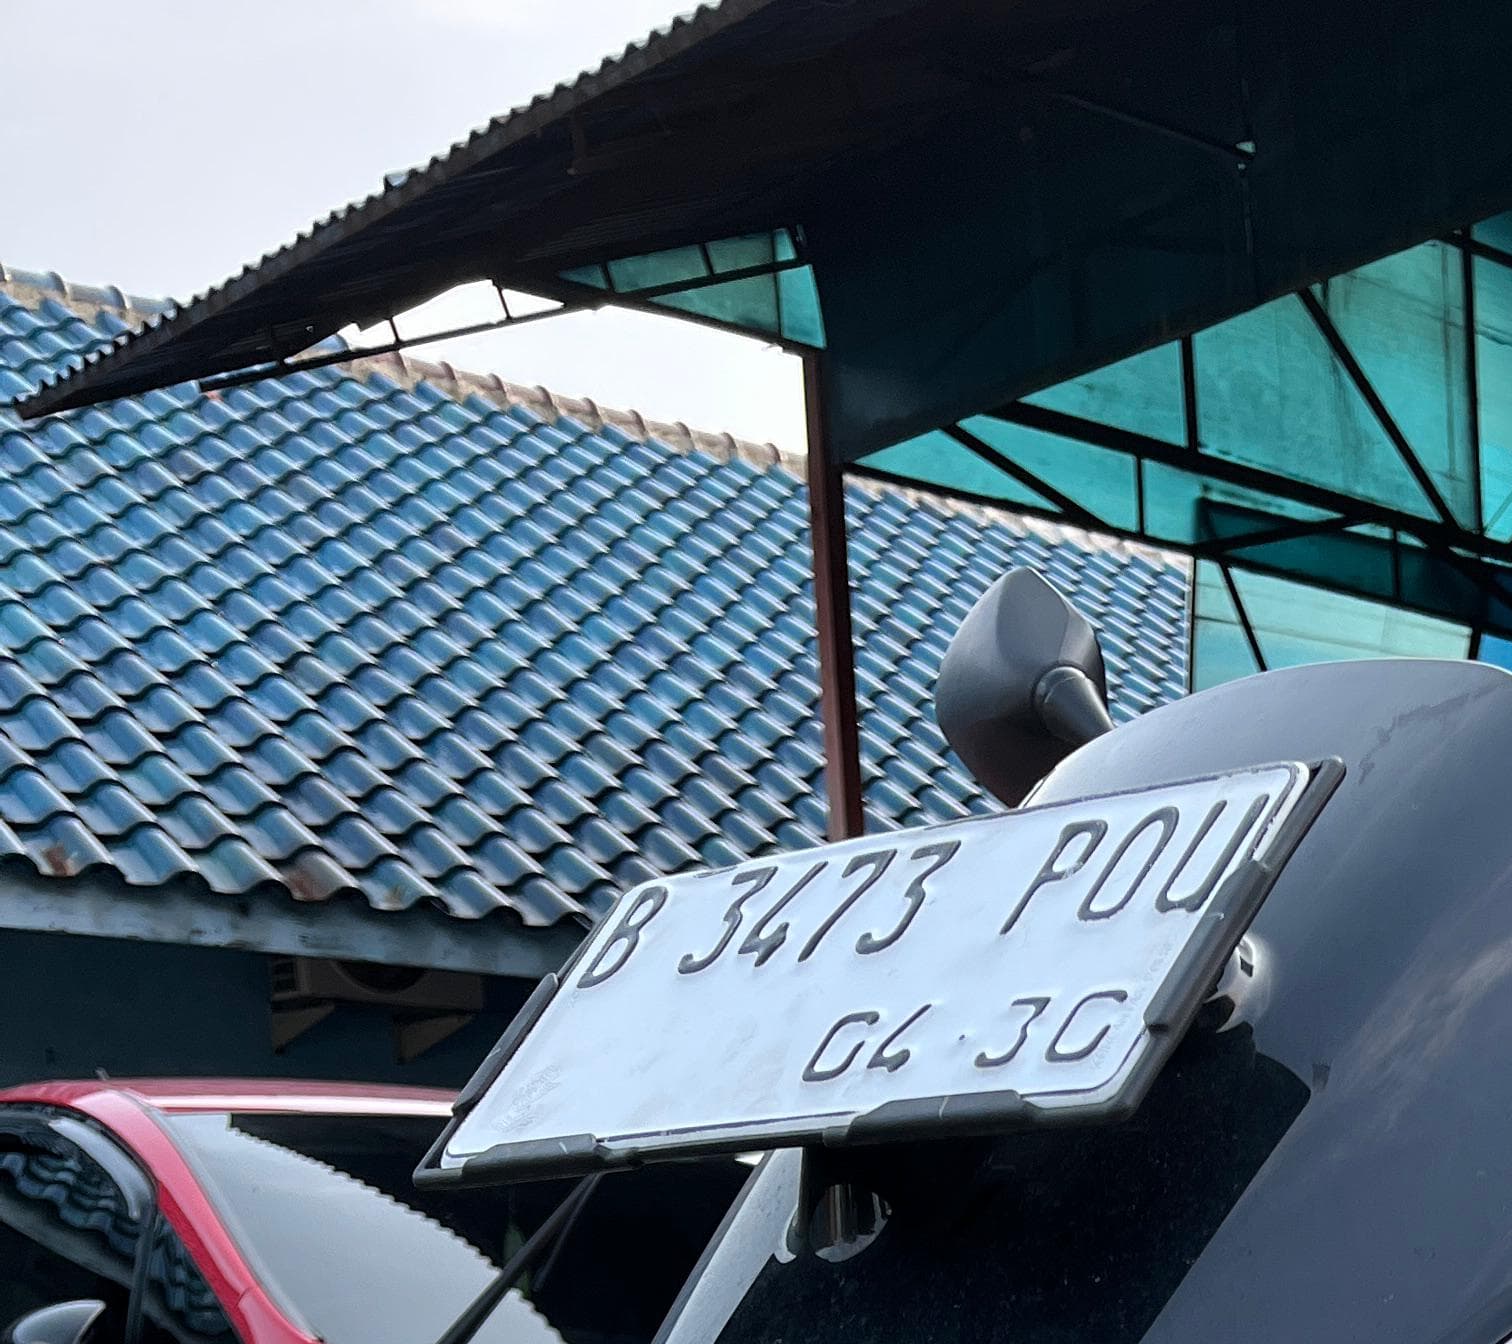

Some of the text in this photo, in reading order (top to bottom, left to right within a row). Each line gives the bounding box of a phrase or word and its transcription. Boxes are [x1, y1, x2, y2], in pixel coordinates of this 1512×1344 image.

[579, 793, 1270, 990] B 3473 POU
